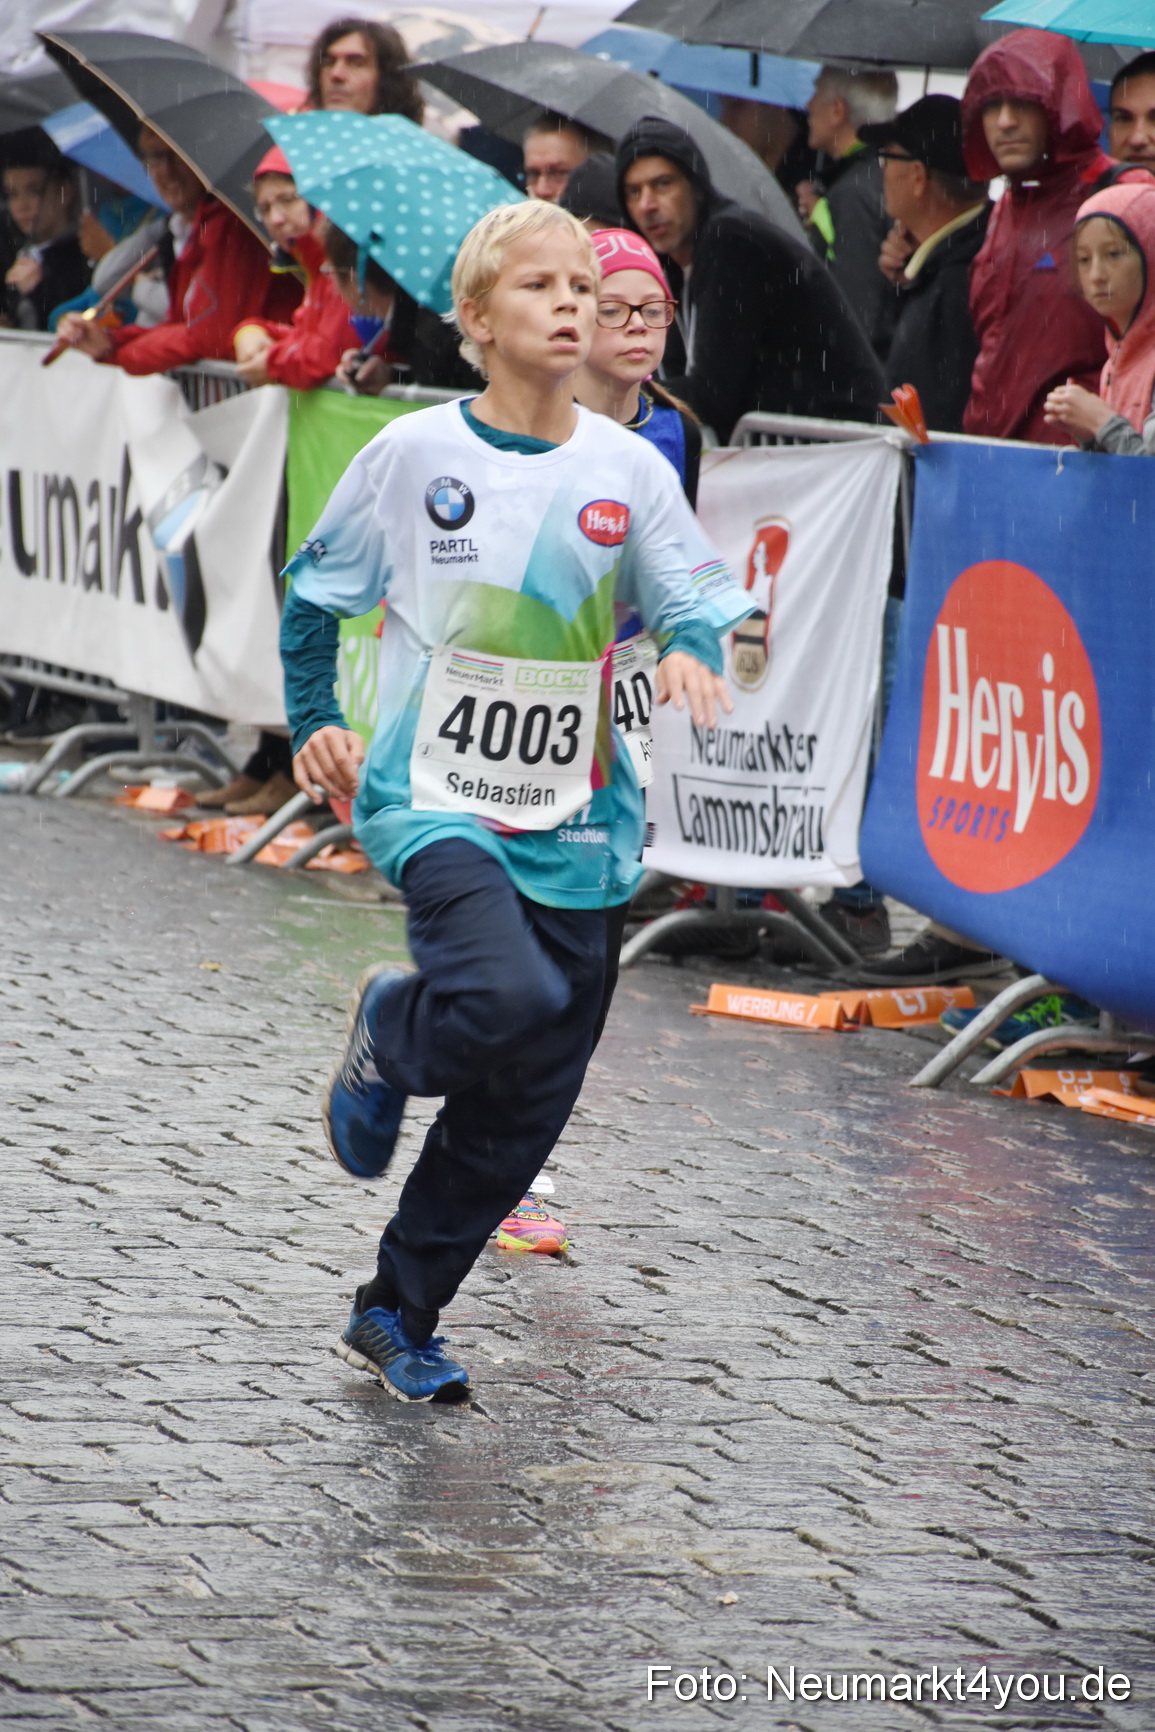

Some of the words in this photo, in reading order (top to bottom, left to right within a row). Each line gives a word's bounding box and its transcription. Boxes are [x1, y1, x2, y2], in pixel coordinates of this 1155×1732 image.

[427, 478, 470, 496] BMW
[587, 508, 627, 535] Hervi
[430, 539, 478, 554] PARTL
[431, 553, 479, 565] Neumarkt
[445, 666, 504, 687] NeuerMarkt
[515, 667, 590, 688] BOCK
[614, 671, 652, 732] 40
[438, 695, 581, 765] 4003
[929, 623, 1090, 834] Hervis
[690, 715, 818, 773] Neumarkter
[446, 772, 555, 806] Sebastian
[927, 796, 1011, 842] SPORTS
[727, 993, 805, 1019] WERBUNG
